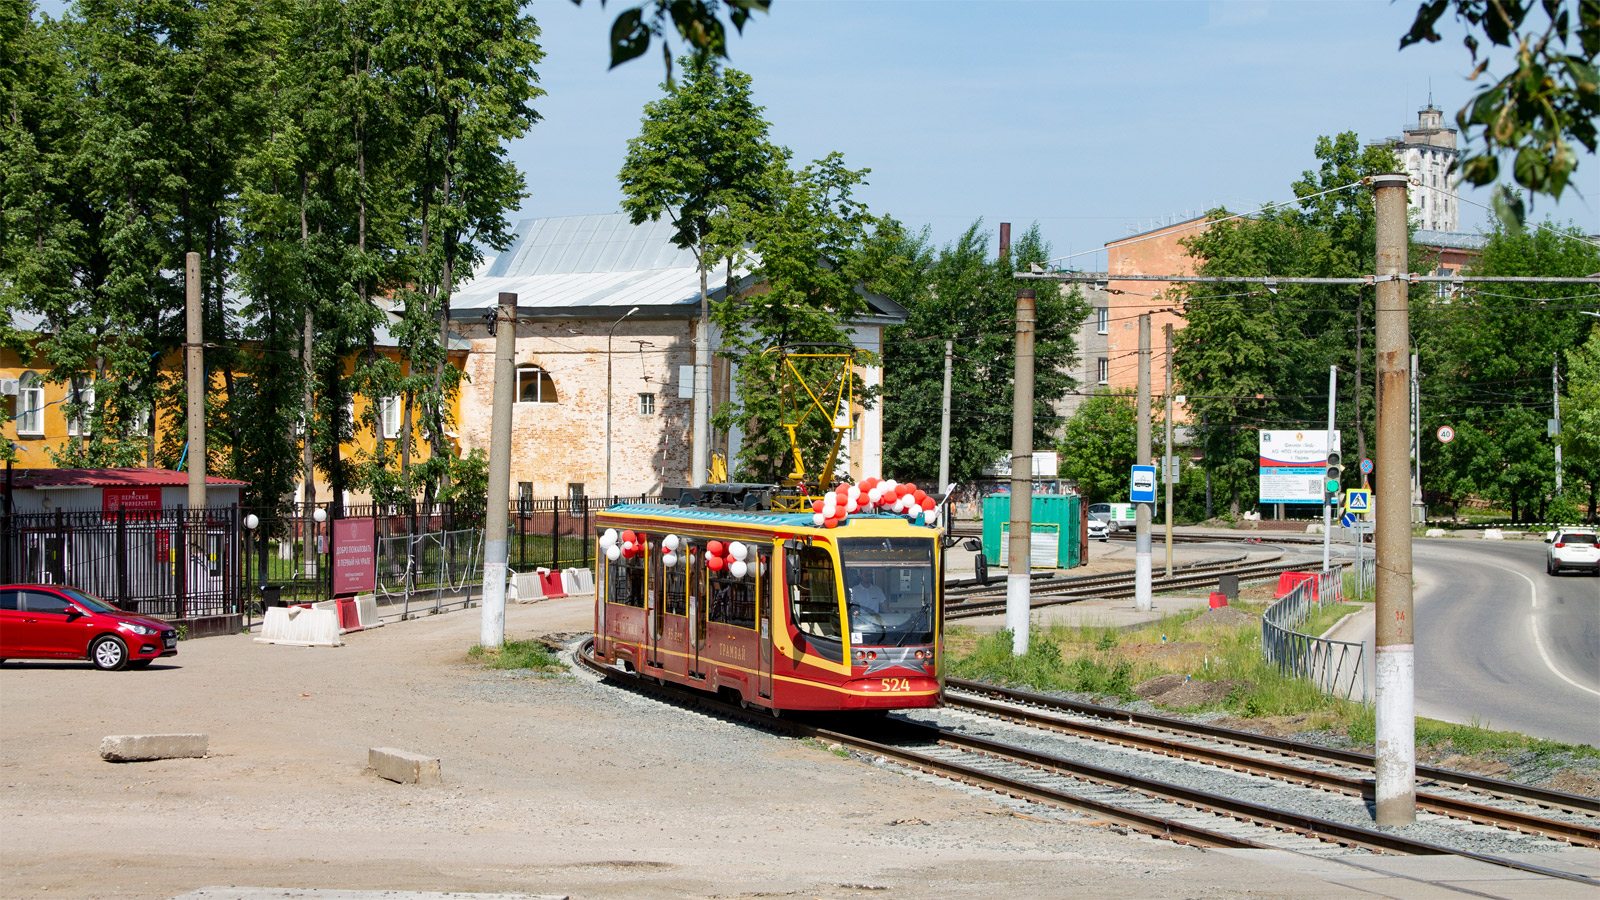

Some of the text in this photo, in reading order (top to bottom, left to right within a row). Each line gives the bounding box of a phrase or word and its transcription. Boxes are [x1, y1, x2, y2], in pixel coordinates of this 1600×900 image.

[336, 545, 372, 555] ДОБРО ПОЖАЛОВАТЬ
[719, 642, 746, 661] ТРАМВАЙ
[881, 678, 911, 692] 524
